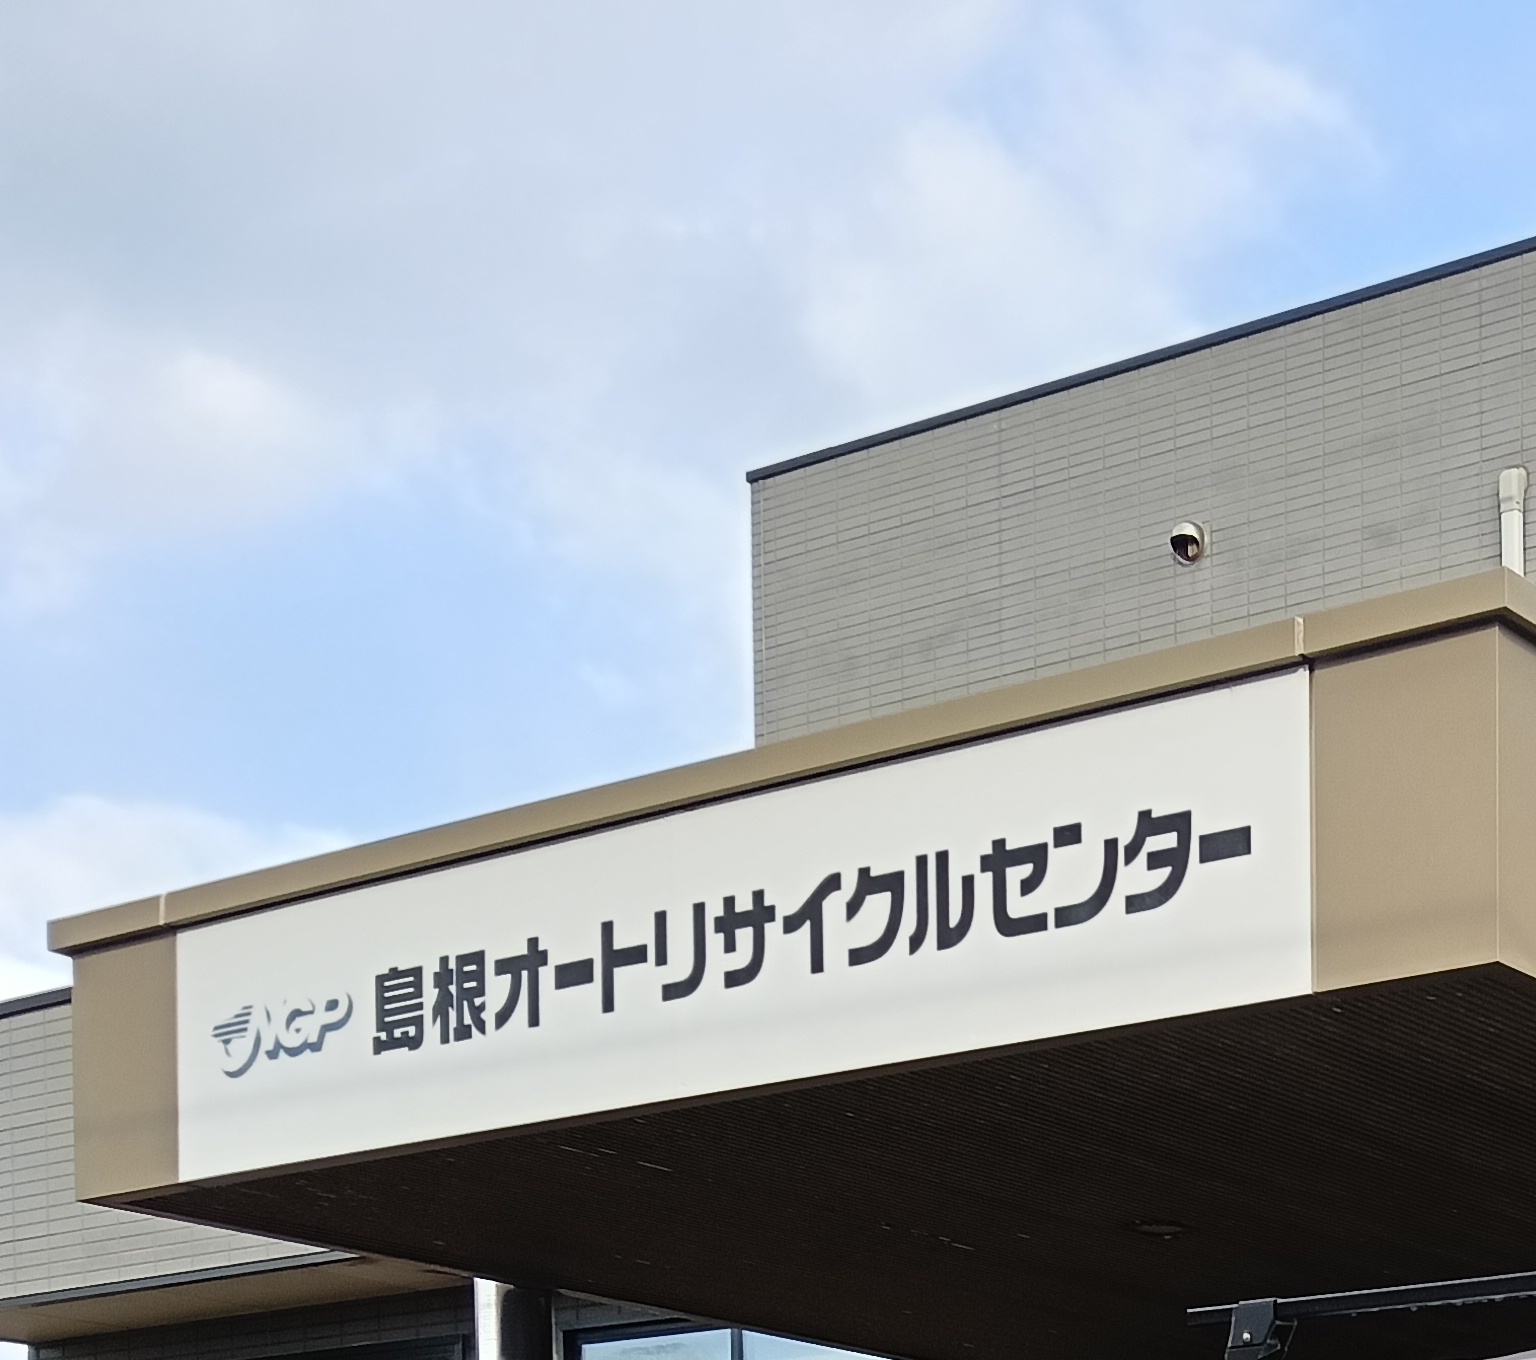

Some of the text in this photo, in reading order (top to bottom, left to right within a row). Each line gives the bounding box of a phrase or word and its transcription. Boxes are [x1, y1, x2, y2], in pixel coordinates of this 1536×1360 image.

[371, 808, 1253, 1057] 島根オートリサイクルセンター
